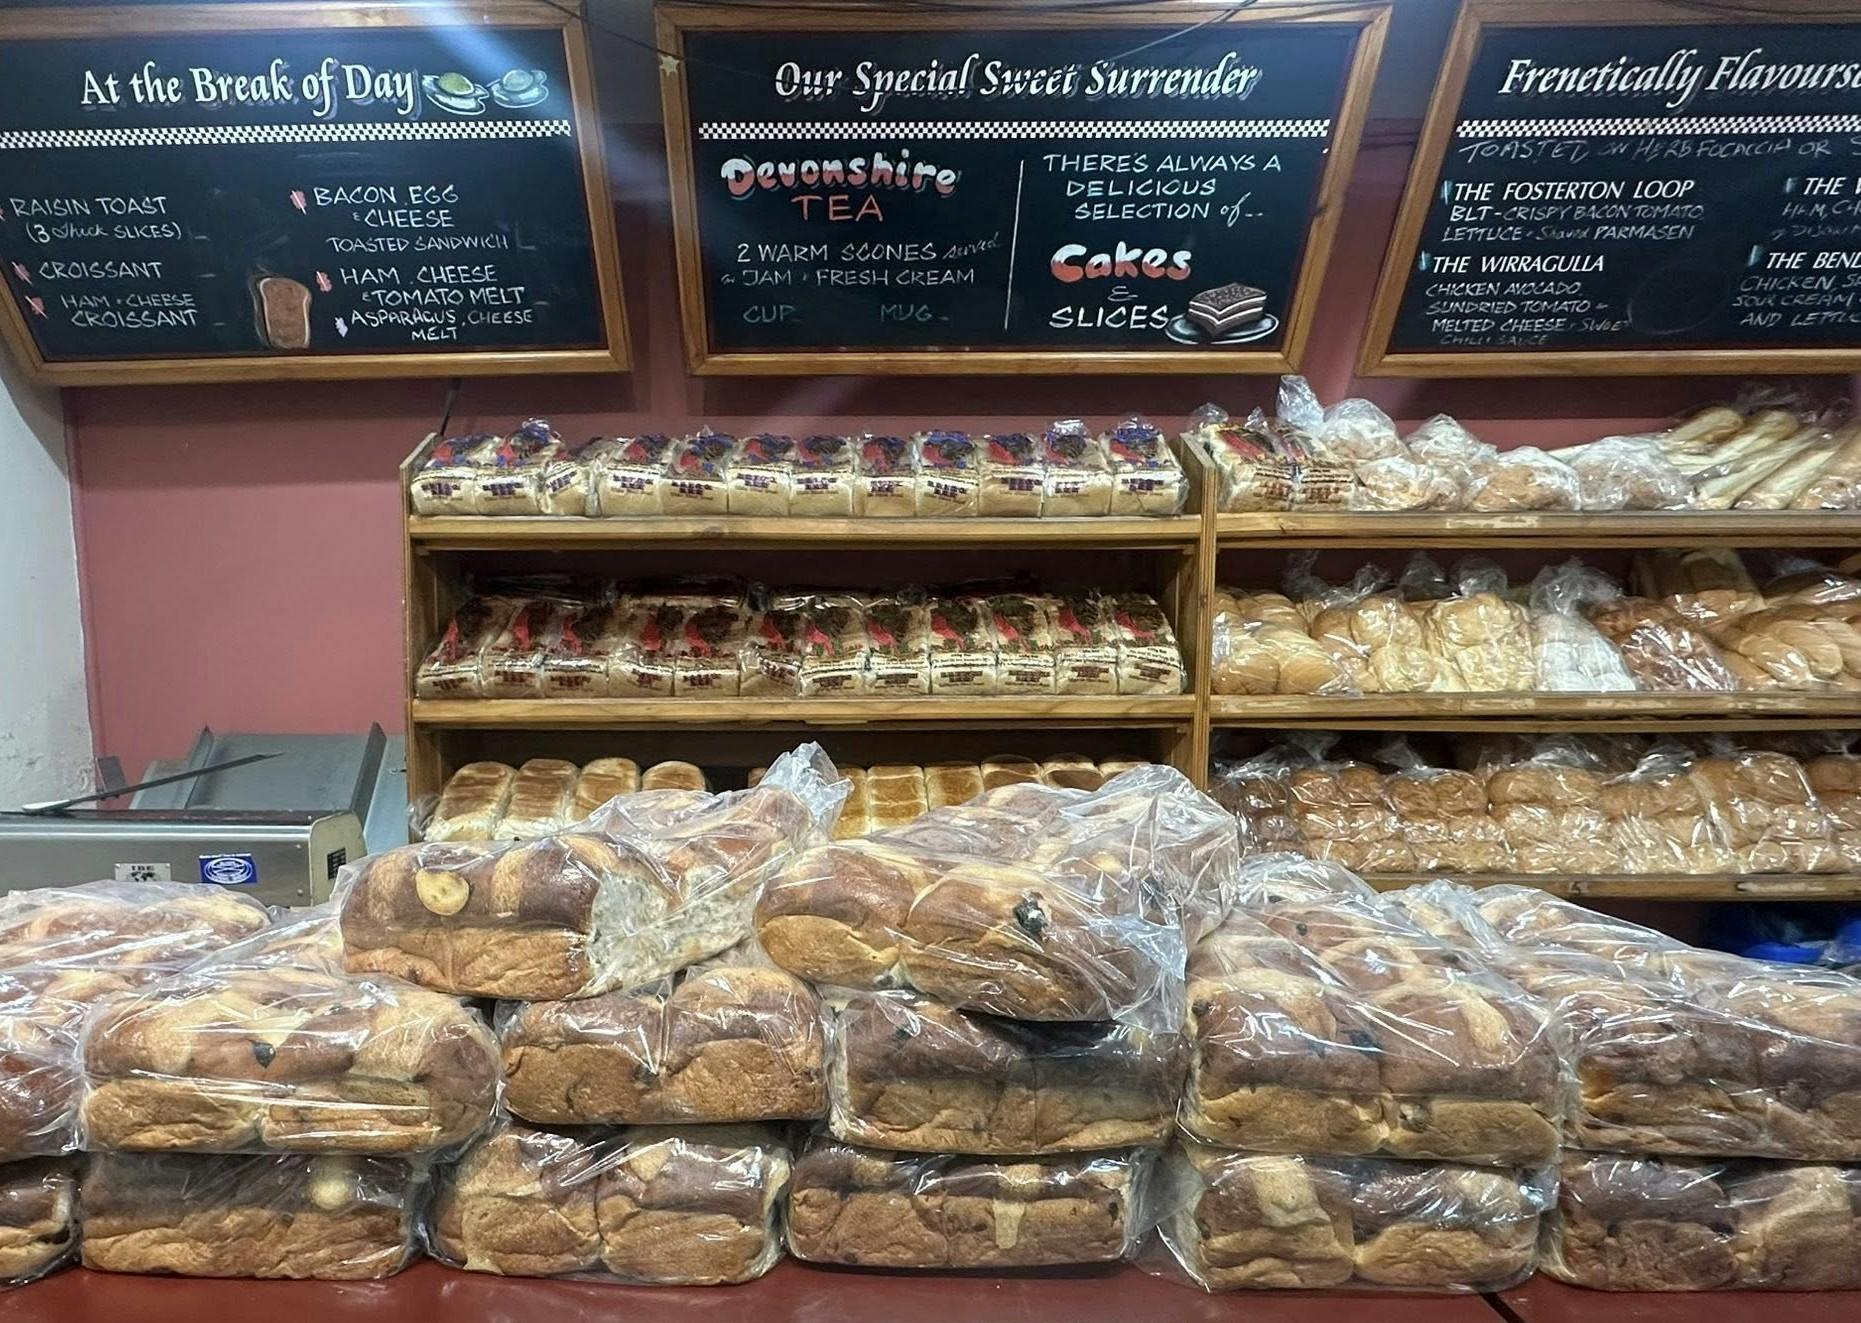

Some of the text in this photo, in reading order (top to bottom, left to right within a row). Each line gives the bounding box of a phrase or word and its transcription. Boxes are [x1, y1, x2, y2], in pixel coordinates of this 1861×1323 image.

[81, 57, 416, 118] At the Break of Day
[774, 52, 1259, 113] Our Special Sweet Surrender
[1498, 48, 1703, 109] Frenetically
[1457, 138, 1590, 165] TOASTED
[1797, 138, 1834, 159] OR
[719, 148, 959, 197] Devonshire
[1155, 154, 1257, 173] ALWAYS
[1261, 154, 1283, 173] A
[1065, 177, 1218, 198] DELICIOUS
[1453, 179, 1695, 201] THE FOSTERTON LOOP
[1803, 176, 1848, 195] THE
[9, 196, 167, 217] RAISIN TOAST
[790, 194, 885, 223] TEA
[1073, 201, 1211, 221] SELECTION
[1502, 204, 1573, 221] CRISPY
[1573, 204, 1633, 221] BACON
[364, 208, 456, 228] CHEESE
[326, 233, 510, 253] TOASTED SANDWICH
[1441, 226, 1523, 242] LETTUCE
[1592, 224, 1695, 241] PARMASEN
[736, 243, 751, 263] 2
[758, 244, 829, 263] WARM
[840, 242, 938, 263] SCONES
[1050, 240, 1193, 284] Cakes
[1766, 251, 1809, 269] THE
[39, 261, 163, 280] CROISSANT
[1432, 254, 1605, 274] THE WIRRAGULLA
[742, 268, 793, 287] JAM
[815, 268, 889, 287] FRESH
[895, 268, 976, 287] CREAM
[371, 288, 465, 307] TOMATO
[469, 286, 525, 305] MELT
[1425, 282, 1501, 298] CHICKEN
[60, 293, 197, 309] HAM CHEESE
[1425, 300, 1591, 316] SUNDRIED TOMATO
[71, 309, 199, 329] CROISSANT
[467, 308, 534, 325] CHEESE
[742, 304, 796, 324] CUP
[1048, 305, 1170, 330] SLICES
[1739, 312, 1783, 328] AND
[411, 327, 459, 342] MELT
[1431, 318, 1496, 333] MELTED
[1499, 317, 1568, 333] CHEESE
